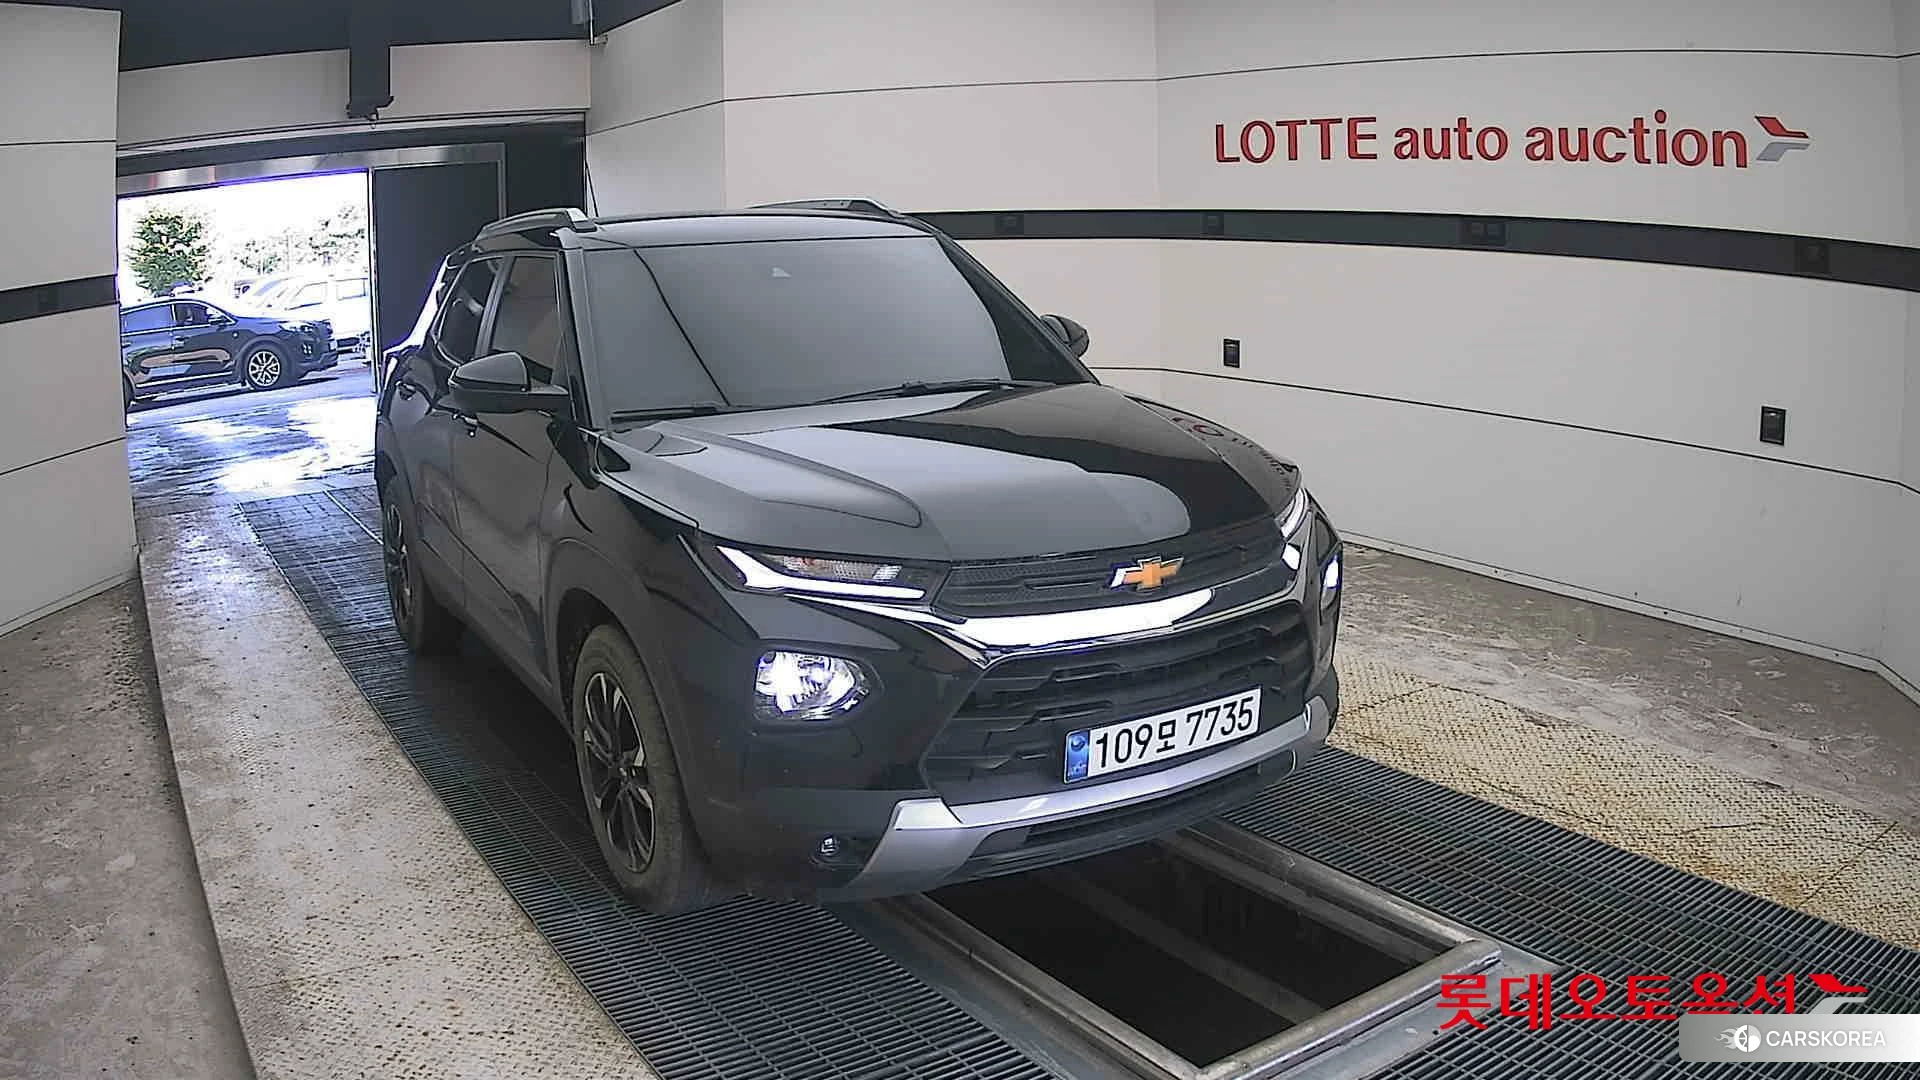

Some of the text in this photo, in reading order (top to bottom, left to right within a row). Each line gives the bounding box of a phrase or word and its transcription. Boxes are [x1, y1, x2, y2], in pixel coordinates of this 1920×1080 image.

[1215, 109, 1749, 169] LOTTE auto auction
[1096, 696, 1254, 769] 109모 7735
